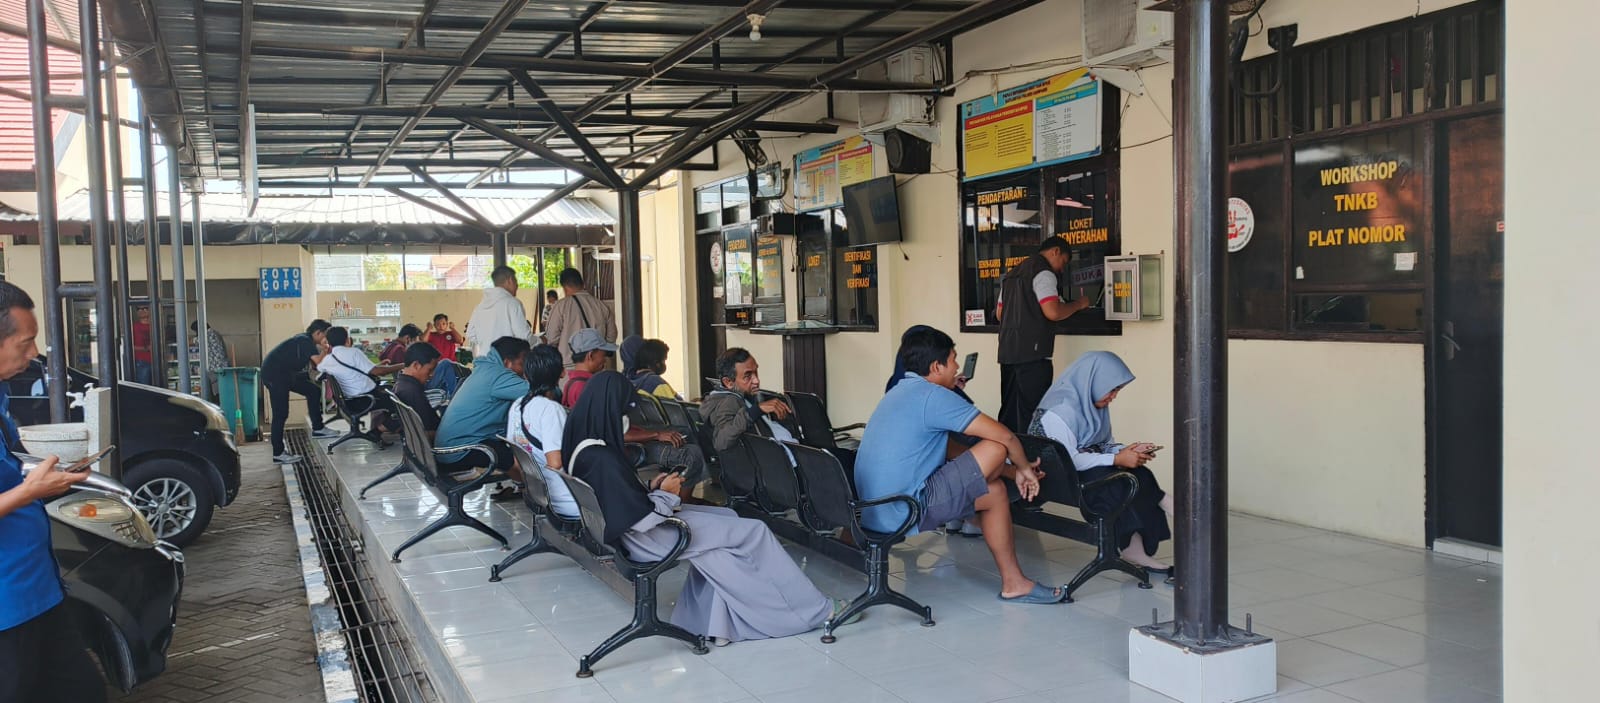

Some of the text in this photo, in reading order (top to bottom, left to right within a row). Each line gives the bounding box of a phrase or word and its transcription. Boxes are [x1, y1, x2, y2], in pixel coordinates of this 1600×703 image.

[1320, 161, 1398, 186] WORKSHOP
[977, 188, 1023, 205] PENDAFTARAN
[1334, 192, 1378, 212] TNKB
[1069, 217, 1093, 230] LOKET
[1308, 224, 1406, 247] PLAT NOMOR
[261, 268, 299, 280] FOTO
[1075, 268, 1103, 282] BUKA
[262, 280, 299, 291] COPY
